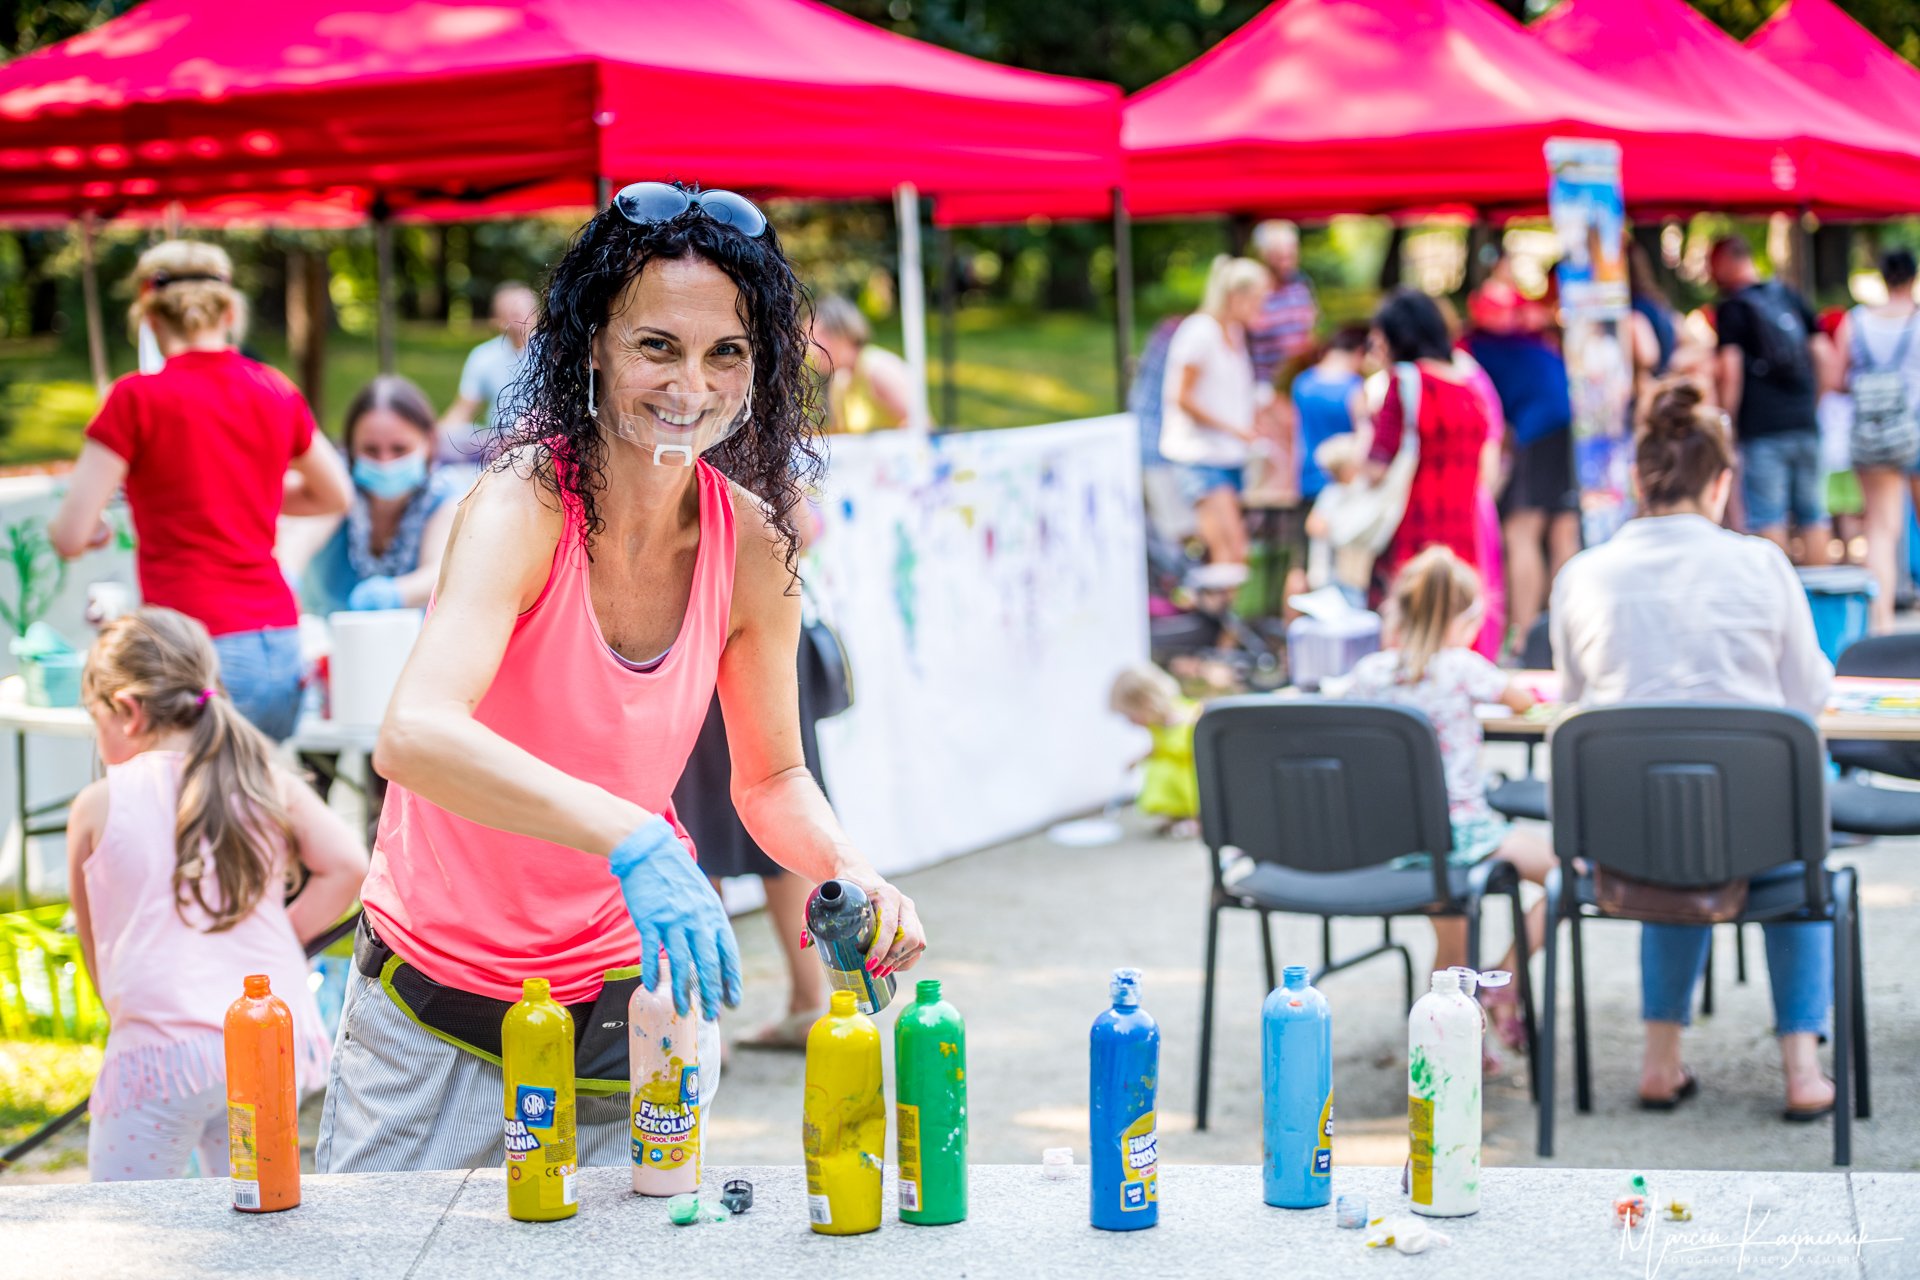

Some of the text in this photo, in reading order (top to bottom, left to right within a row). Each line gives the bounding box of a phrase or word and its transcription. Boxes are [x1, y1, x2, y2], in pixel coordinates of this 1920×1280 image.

[524, 1094, 545, 1115] ASTRA
[641, 1101, 690, 1119] FARBA
[635, 1112, 696, 1134] SZKOLNA
[642, 1133, 689, 1143] SCHOOL PAINT
[1128, 1144, 1157, 1168] SZKOL
